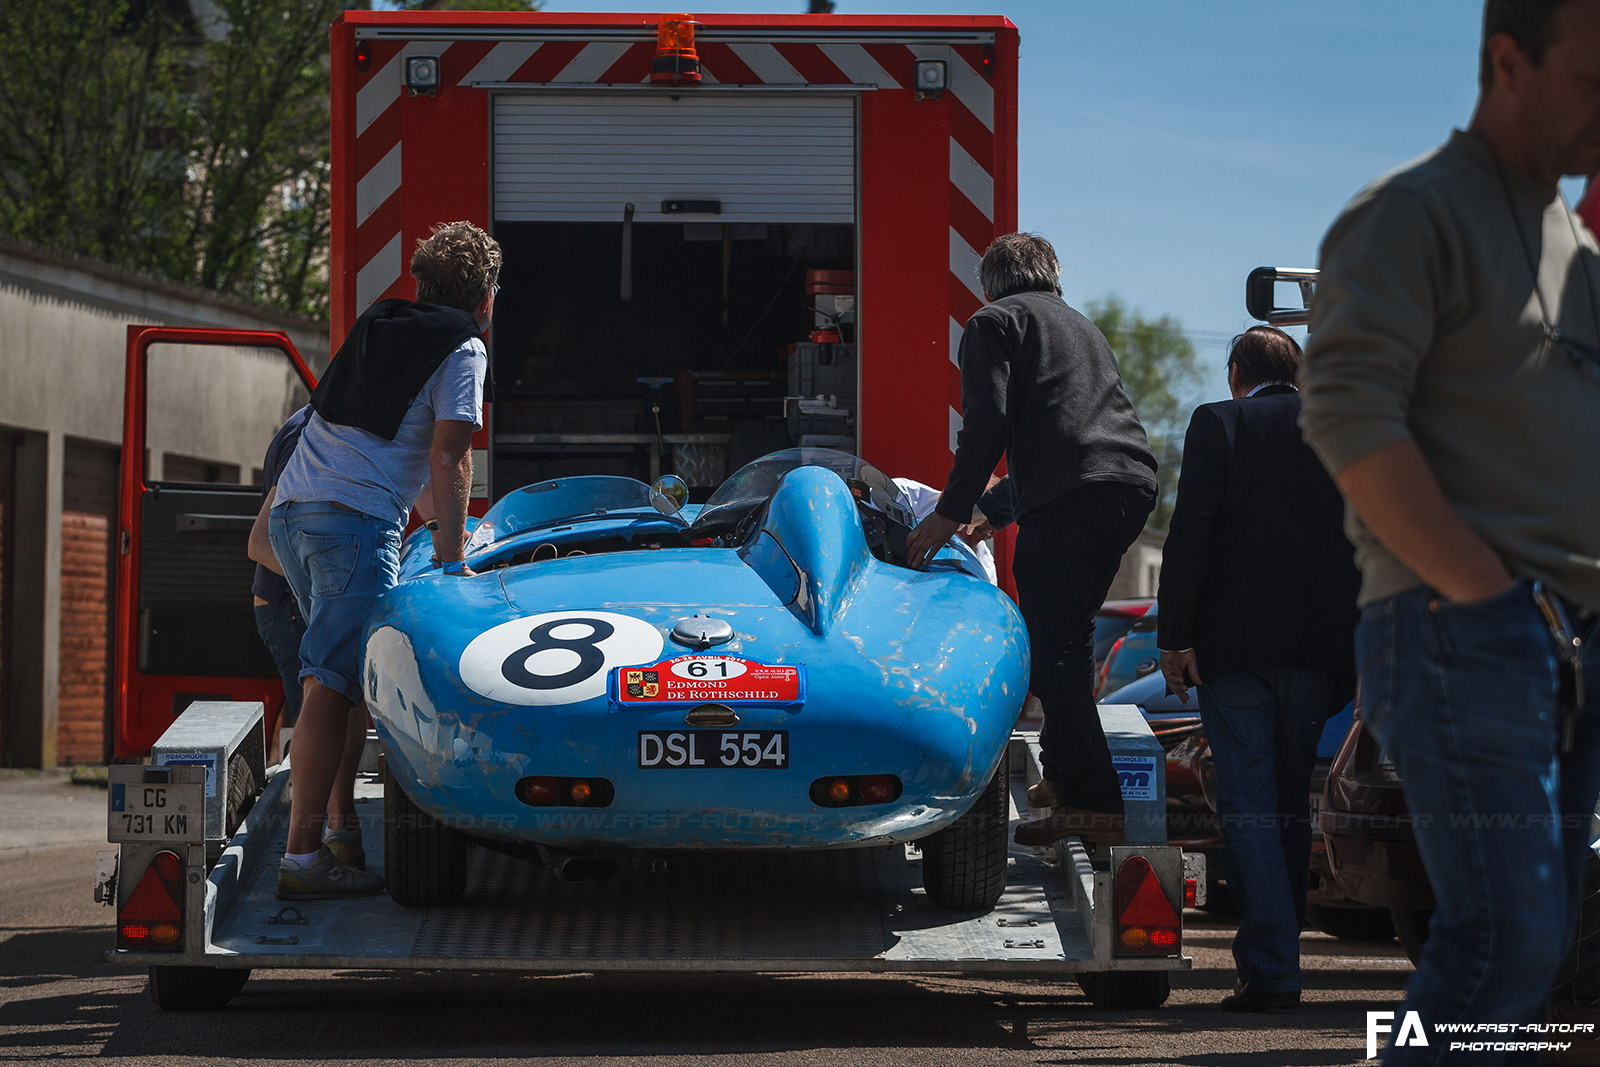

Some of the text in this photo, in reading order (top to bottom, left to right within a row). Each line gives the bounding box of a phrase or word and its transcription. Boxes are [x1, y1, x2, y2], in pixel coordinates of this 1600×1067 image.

[501, 618, 615, 690] 8
[687, 661, 728, 677] 61
[666, 680, 728, 689] EDMOND
[689, 690, 779, 699] ROTHSCHILD
[640, 733, 786, 766] DSL 554
[143, 788, 167, 808] CG
[122, 814, 153, 834] 731
[164, 814, 187, 834] KM
